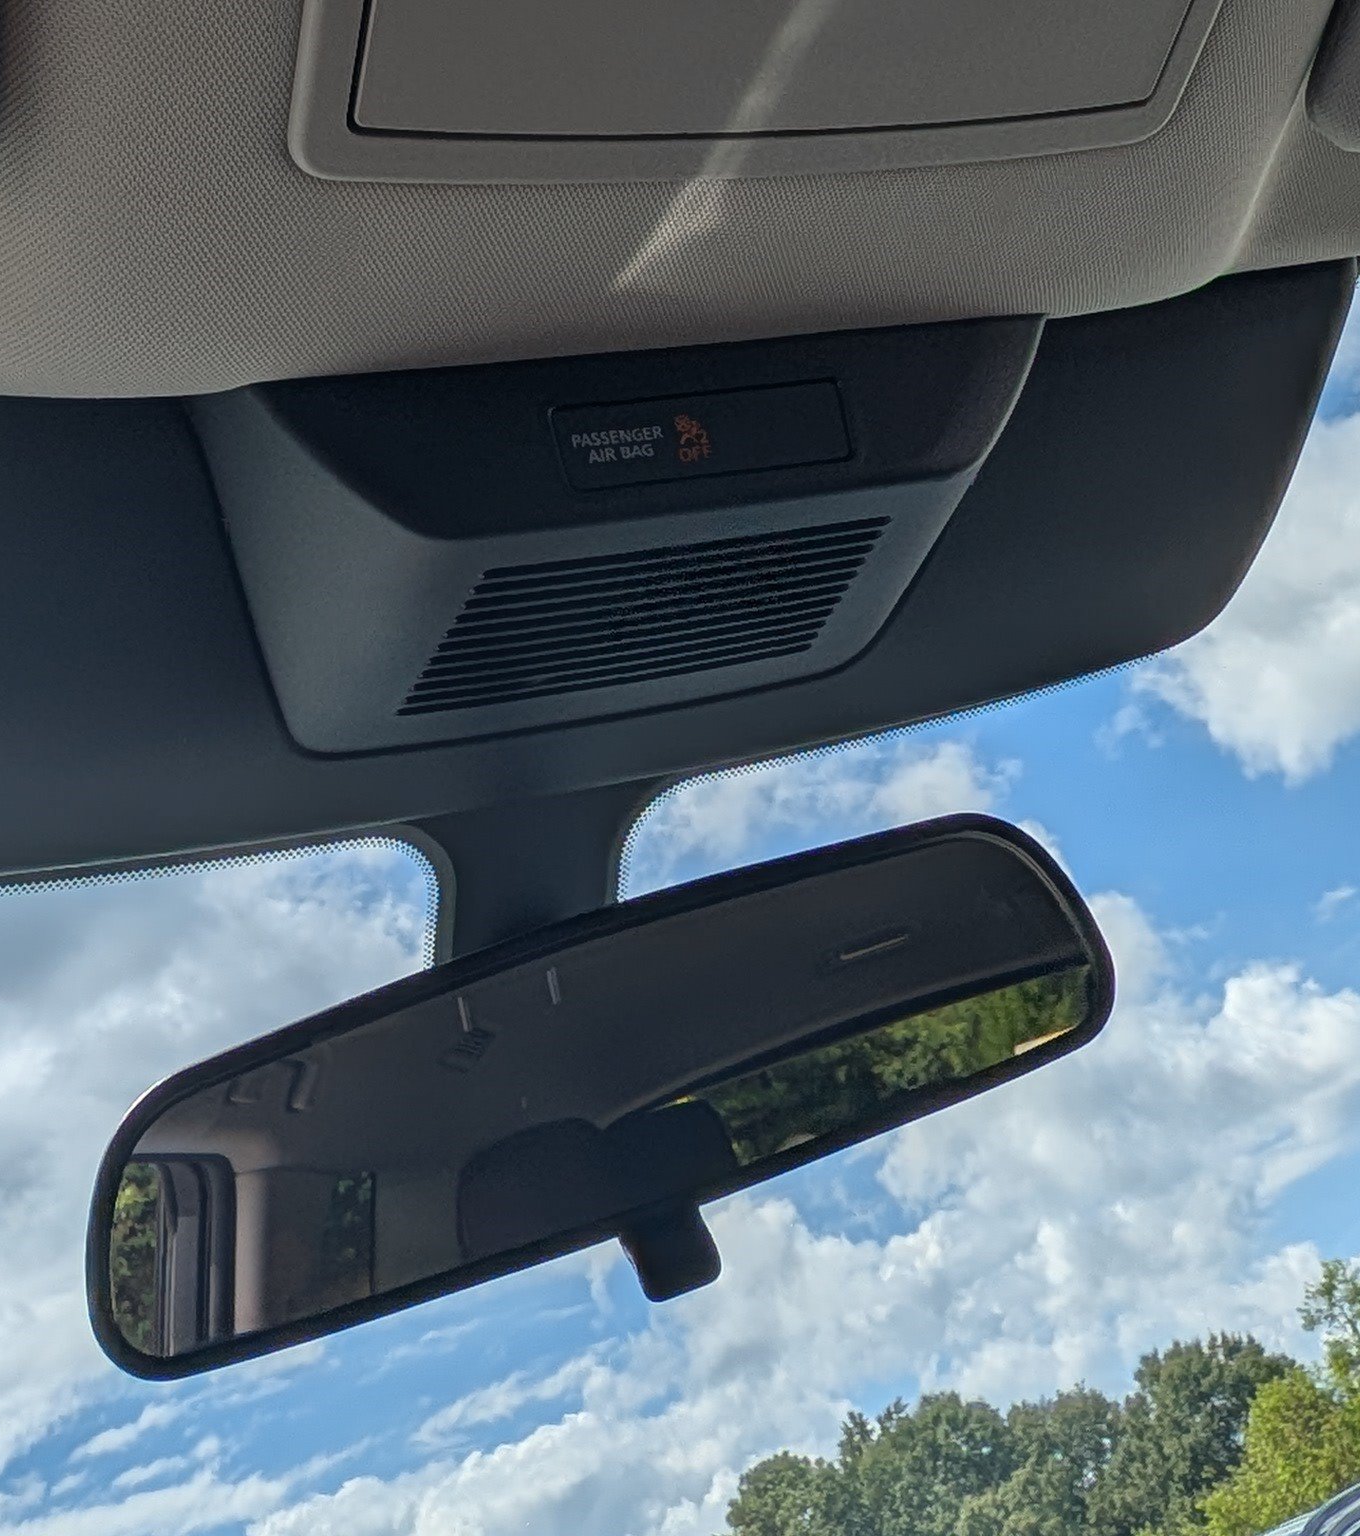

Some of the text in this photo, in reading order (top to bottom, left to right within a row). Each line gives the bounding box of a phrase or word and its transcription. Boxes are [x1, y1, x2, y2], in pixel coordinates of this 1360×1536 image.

[571, 425, 664, 449] PASSENGER
[588, 442, 655, 464] AIR BAG
[678, 443, 712, 463] OFF
